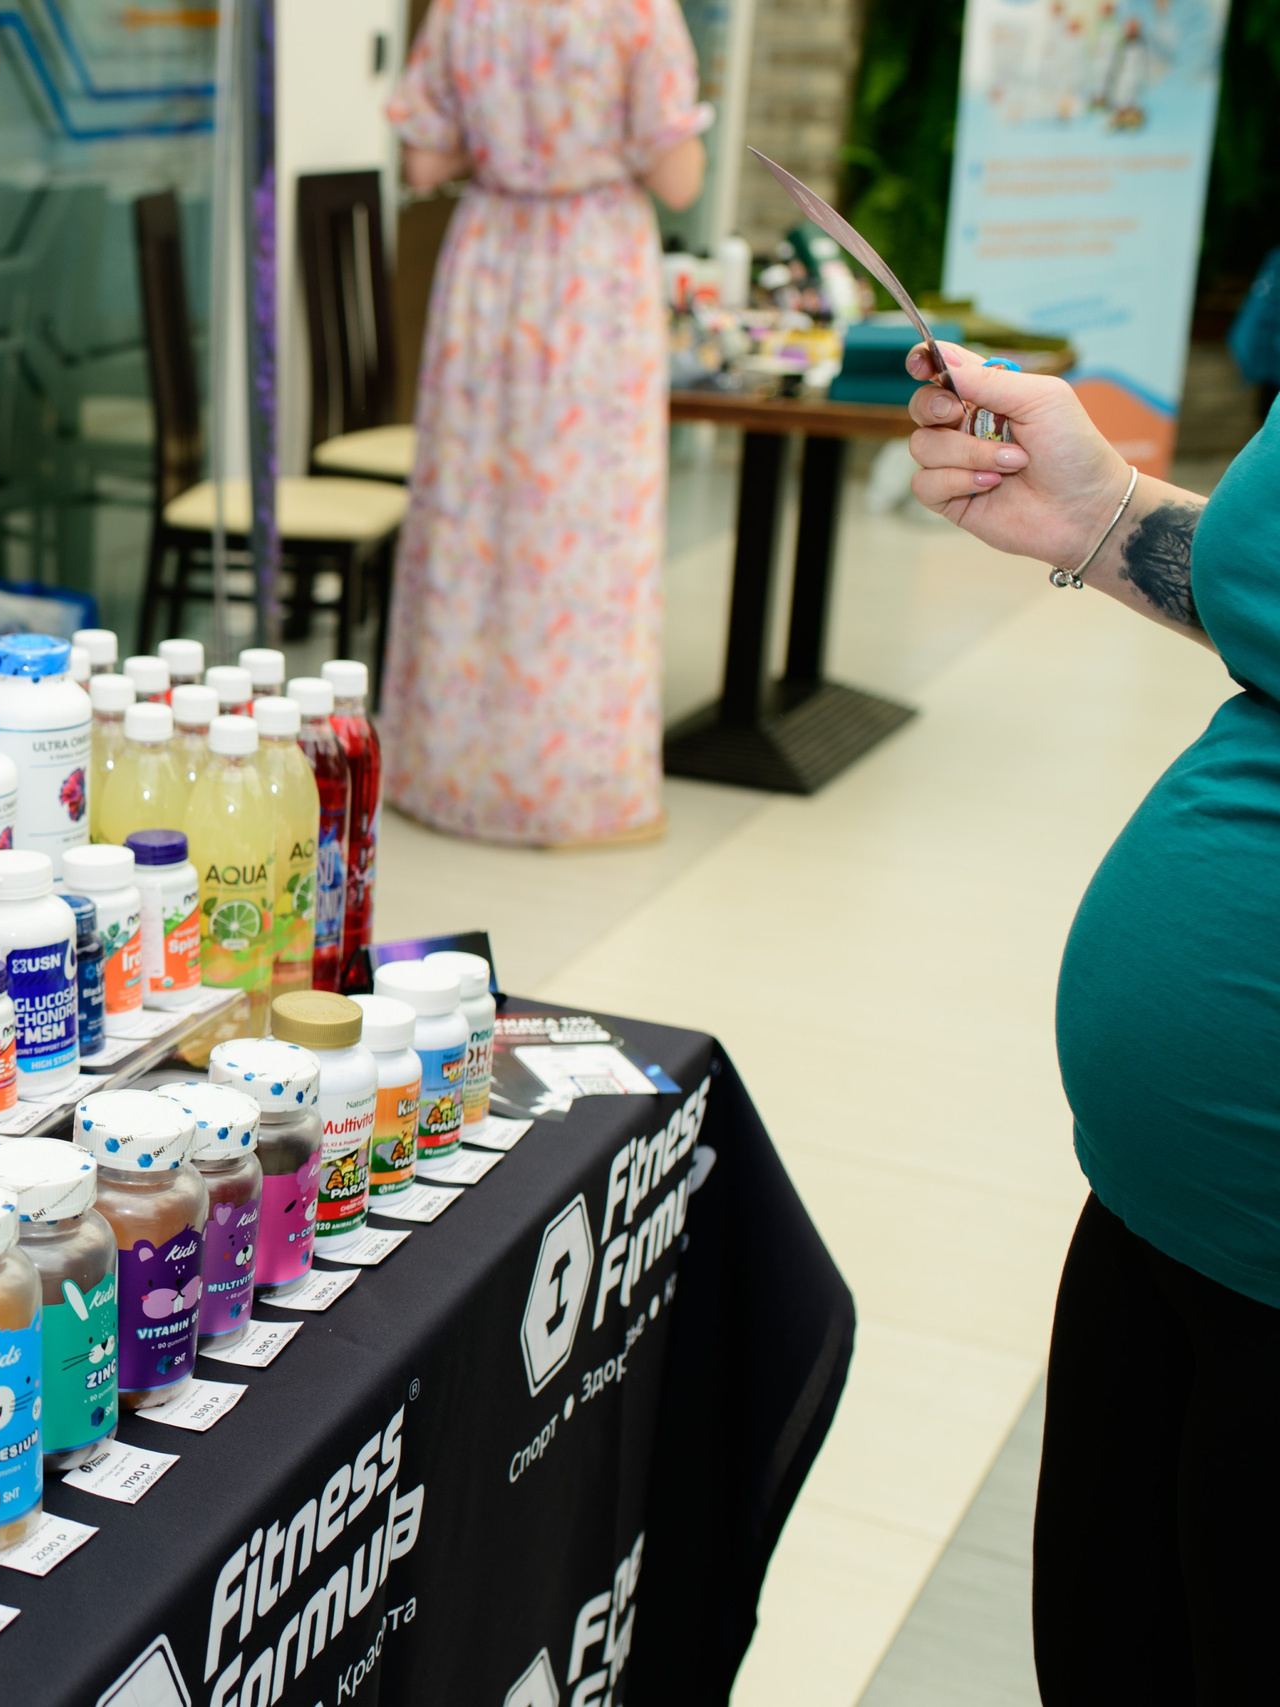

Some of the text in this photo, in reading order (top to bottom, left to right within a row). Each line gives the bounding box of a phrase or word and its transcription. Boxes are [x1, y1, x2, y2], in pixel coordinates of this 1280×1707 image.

[33, 740, 68, 753] ULTRA
[205, 864, 268, 886] AQUA
[28, 953, 62, 973] USN
[33, 1042, 60, 1055] SUPPORT
[31, 1058, 52, 1071] HIGH
[120, 1134, 135, 1146] SNT
[152, 1147, 166, 1159] SNT
[600, 1075, 711, 1246] Fitness
[236, 1207, 259, 1228] Kids
[315, 1222, 331, 1232] 120
[165, 1241, 197, 1263] Kids
[88, 1283, 115, 1310] Kids
[137, 1319, 190, 1341] VITAMIN
[158, 1335, 190, 1350] 90 gummies
[174, 1352, 186, 1366] SNT
[85, 1358, 117, 1390] ZINC
[190, 1402, 210, 1420] 1590
[509, 1413, 560, 1484] Спорт
[120, 1469, 145, 1489] 1790
[2, 1487, 20, 1503] SNT
[31, 1541, 60, 1561] 2290
[204, 1402, 406, 1684] Fitness
